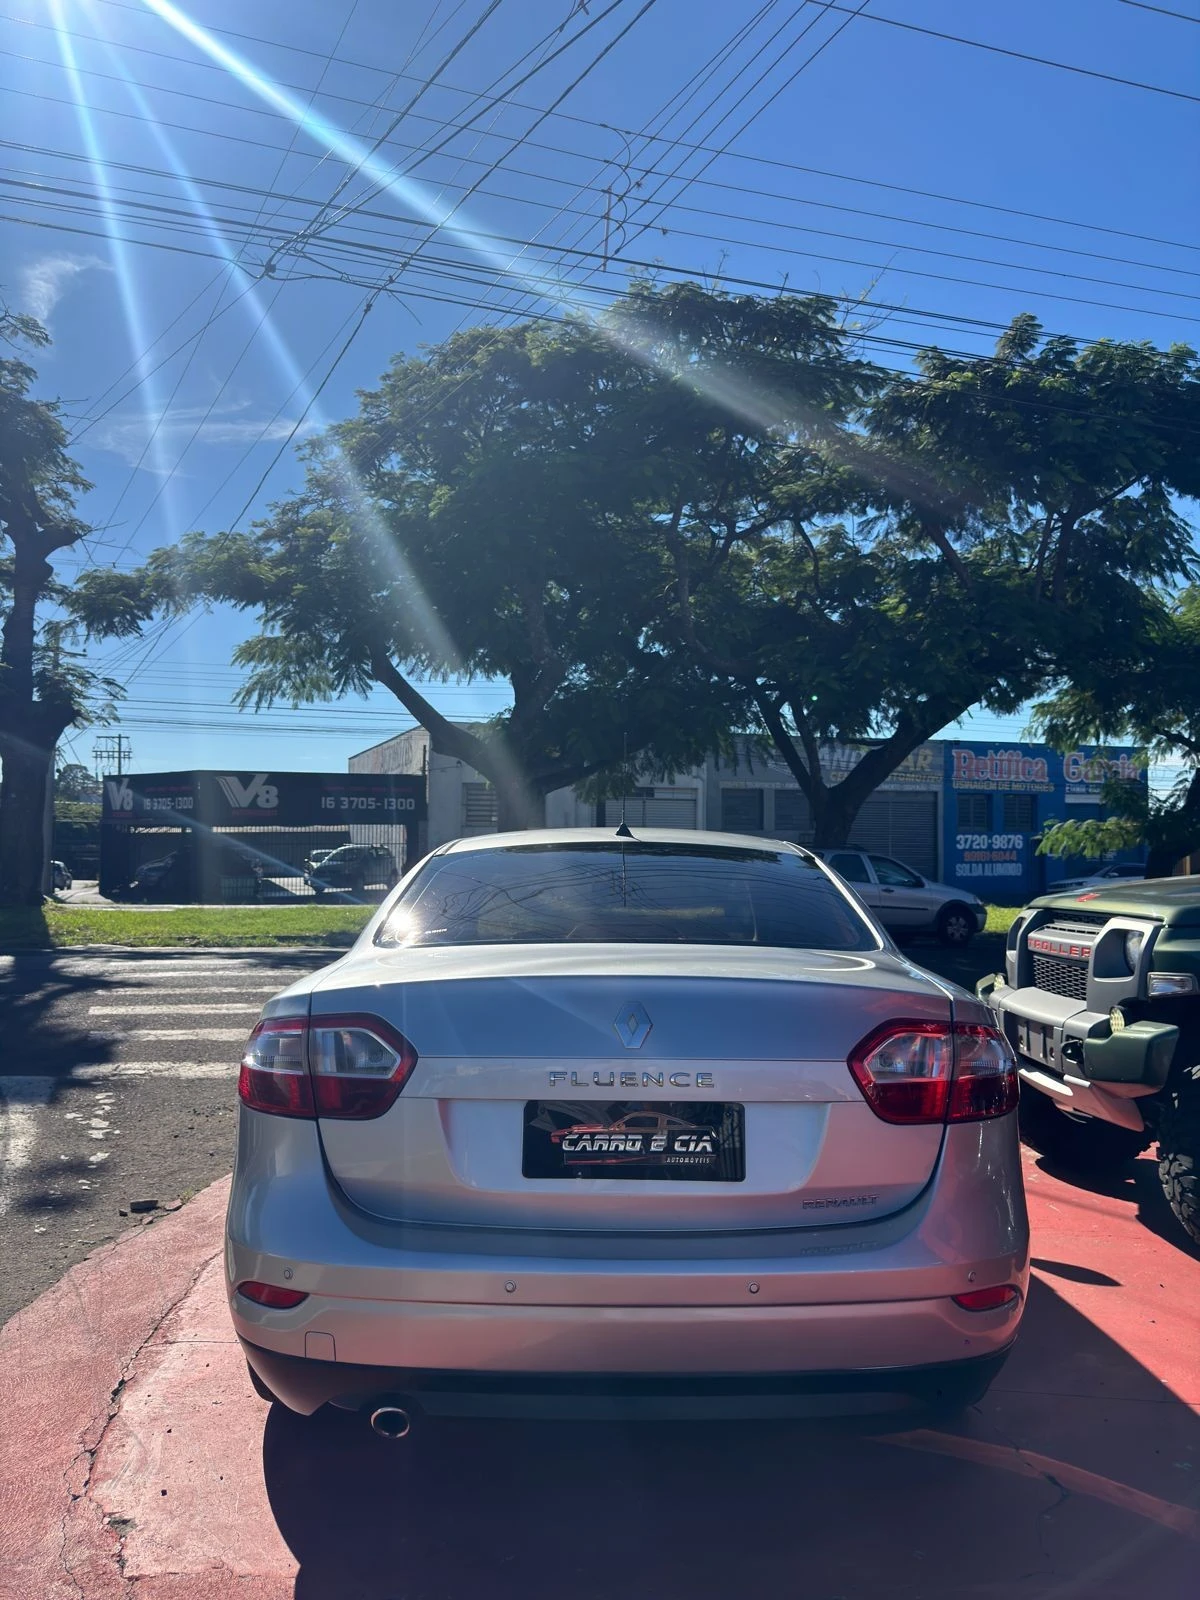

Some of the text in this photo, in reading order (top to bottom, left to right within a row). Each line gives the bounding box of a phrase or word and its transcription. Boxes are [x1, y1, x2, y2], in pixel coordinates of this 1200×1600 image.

[106, 778, 133, 810] V8
[214, 774, 279, 808] V8
[1011, 782, 1055, 792] MOTORES
[321, 797, 415, 810] 16 3705-1300
[955, 863, 983, 877] SOLDA
[1028, 939, 1091, 958] TROLLER
[548, 1071, 715, 1088] FLUENCE
[562, 1134, 712, 1153] CARRO E CIA
[802, 1195, 879, 1209] RENAULT
